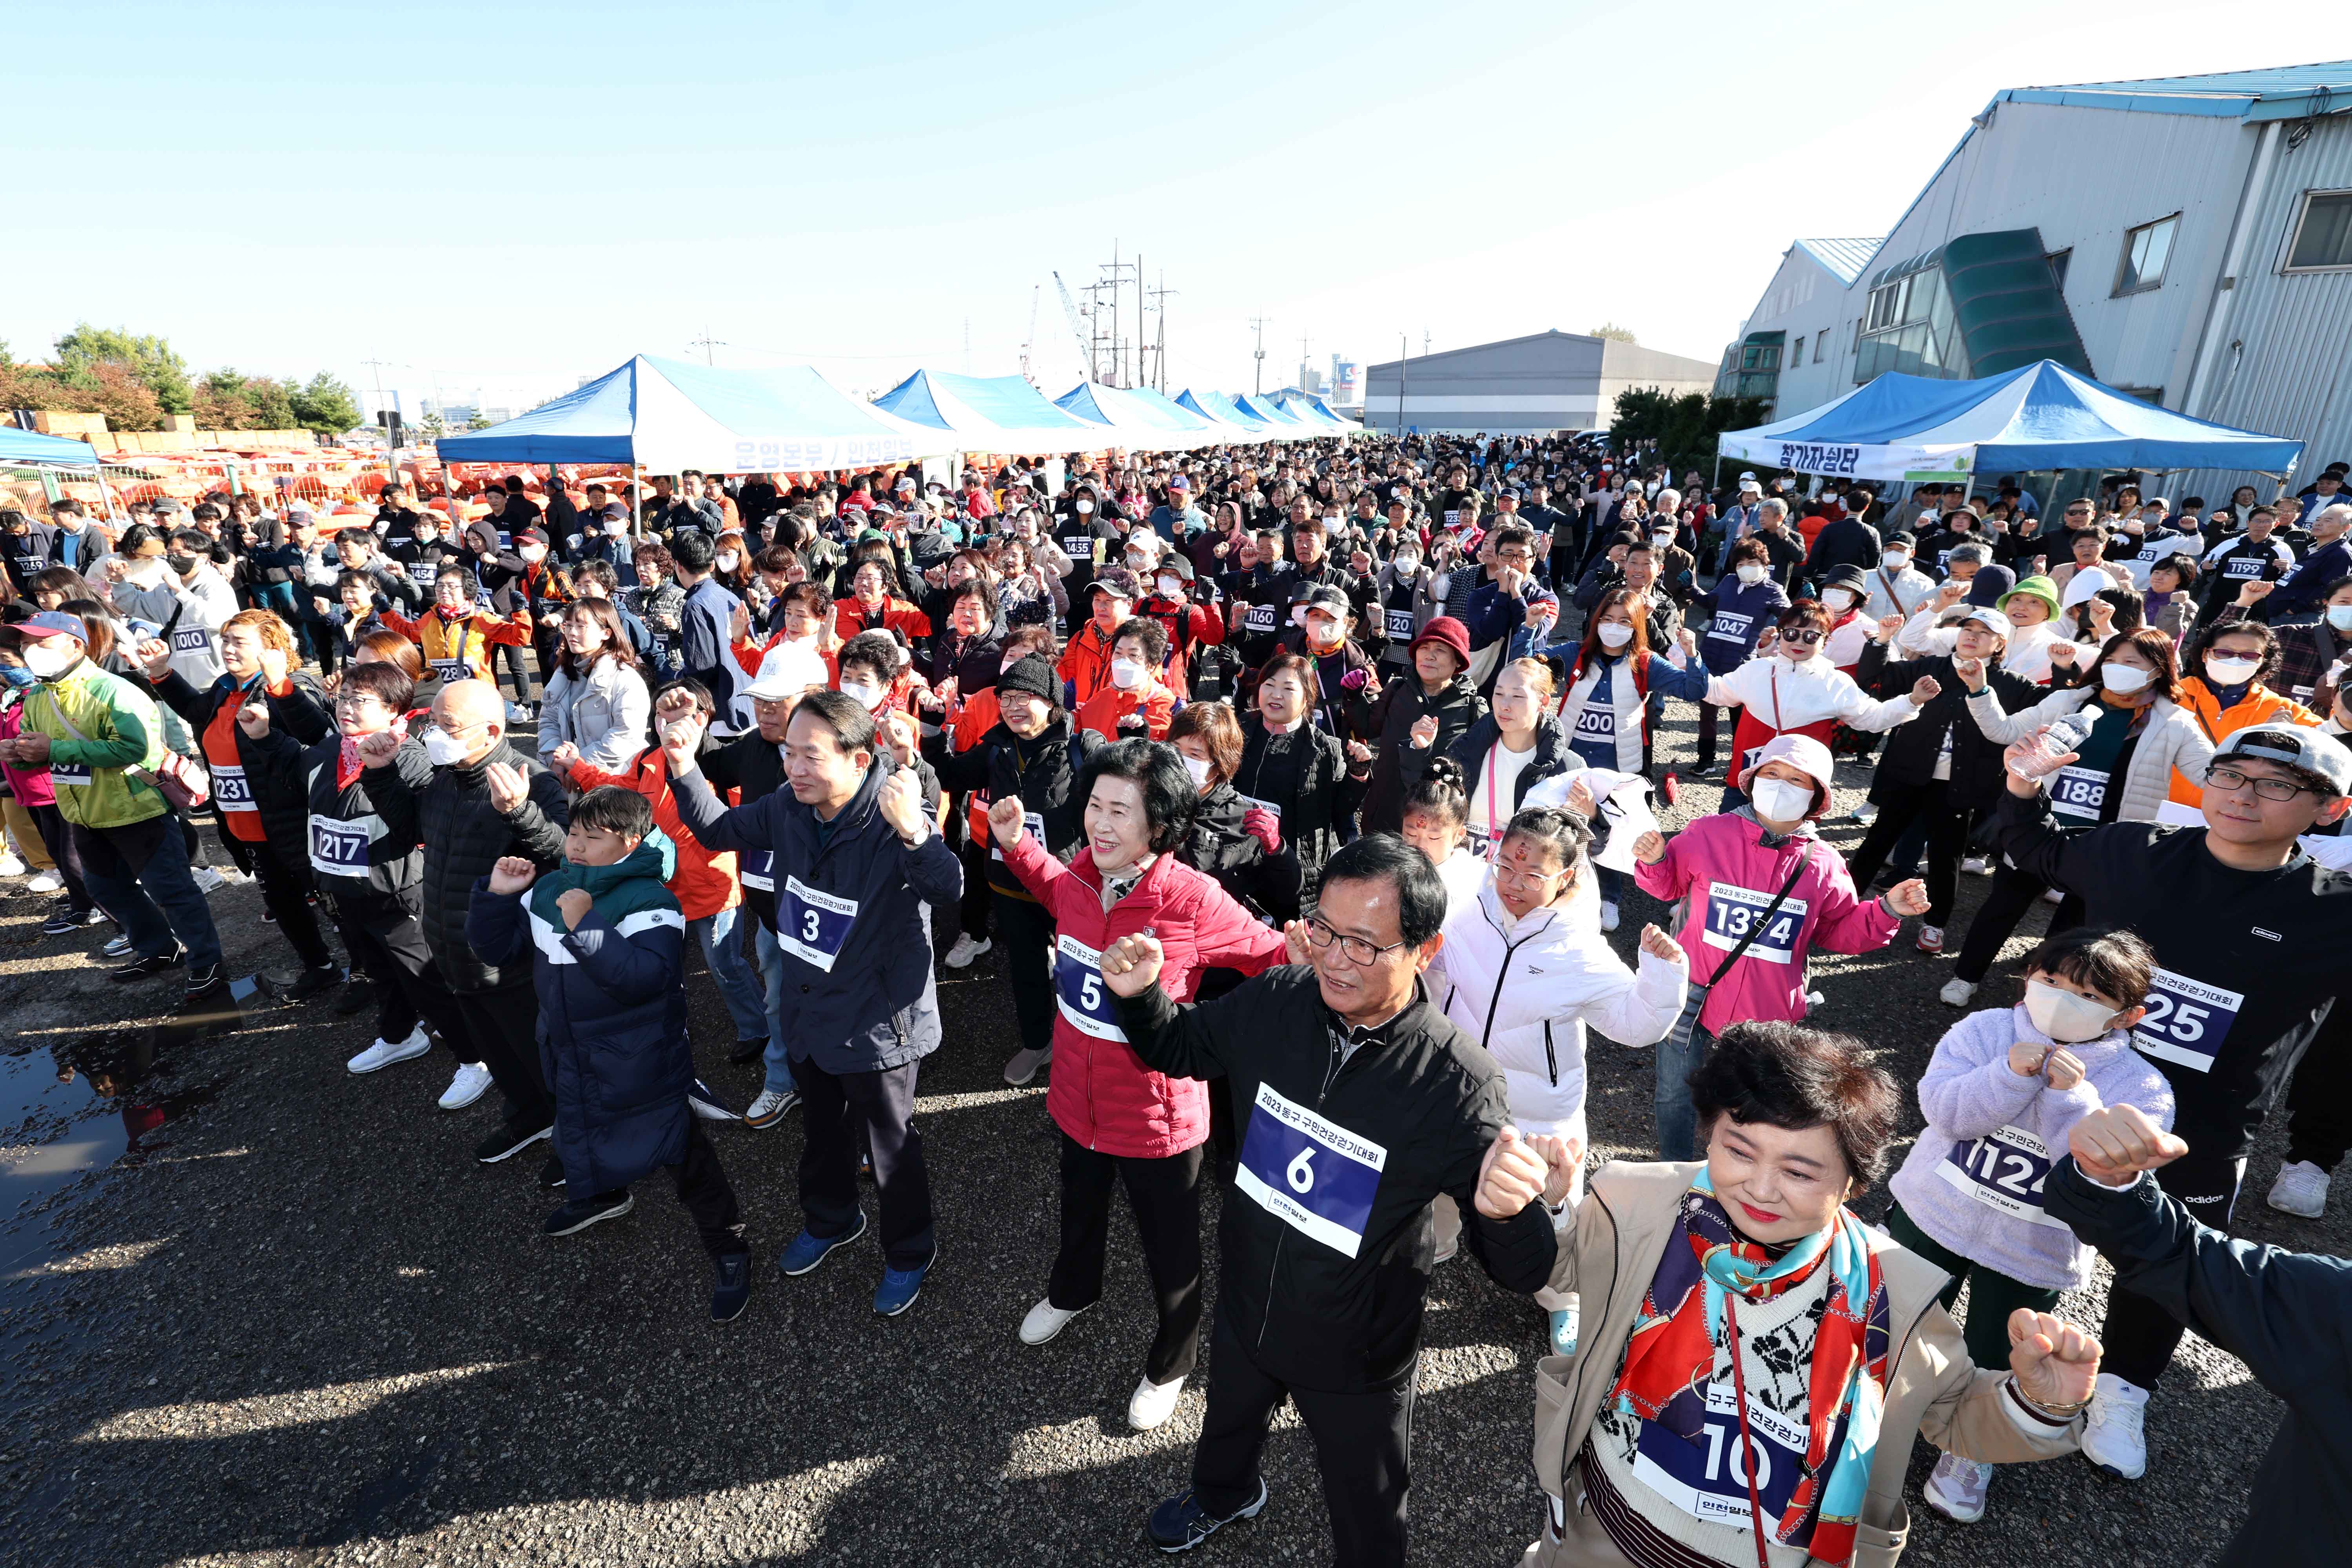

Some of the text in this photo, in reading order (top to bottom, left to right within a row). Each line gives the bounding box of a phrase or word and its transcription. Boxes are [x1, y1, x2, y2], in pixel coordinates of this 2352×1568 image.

[735, 443, 822, 469] 운영본부
[1780, 444, 1860, 474] 참가자쉼터
[1066, 543, 1089, 553] 1455
[20, 561, 43, 571] 1269
[411, 569, 434, 580] 1454
[2231, 563, 2260, 574] 1199
[1249, 610, 1274, 624] 1160
[1715, 619, 1747, 635] 1047
[175, 632, 203, 648] 1010
[213, 778, 251, 799] 1231
[2061, 779, 2106, 806] 188
[318, 830, 361, 861] 1217
[806, 892, 853, 913] 구민건강걷기대회
[1714, 887, 1803, 912] 2023 동구 구민건기대회
[802, 909, 820, 942] 3
[1063, 940, 1077, 954] 2023
[1077, 949, 1087, 959] 동구
[1528, 964, 1544, 973] Reebok
[1080, 972, 1103, 1011] 5
[1076, 1016, 1100, 1032] 인천일보
[2138, 993, 2211, 1042] 25
[1261, 1092, 1379, 1163] 2023 동구 구민건강걷기대회
[2005, 1131, 2047, 1155] 구민건강
[1286, 1145, 1315, 1194] 6
[1980, 1190, 2020, 1211] 인천일보
[2185, 1194, 2224, 1204] adidas
[1273, 1198, 1307, 1223] 인천일보
[1706, 1392, 1722, 1406] 구
[1703, 1423, 1771, 1490] 10
[1702, 1501, 1753, 1518] 인천일보
